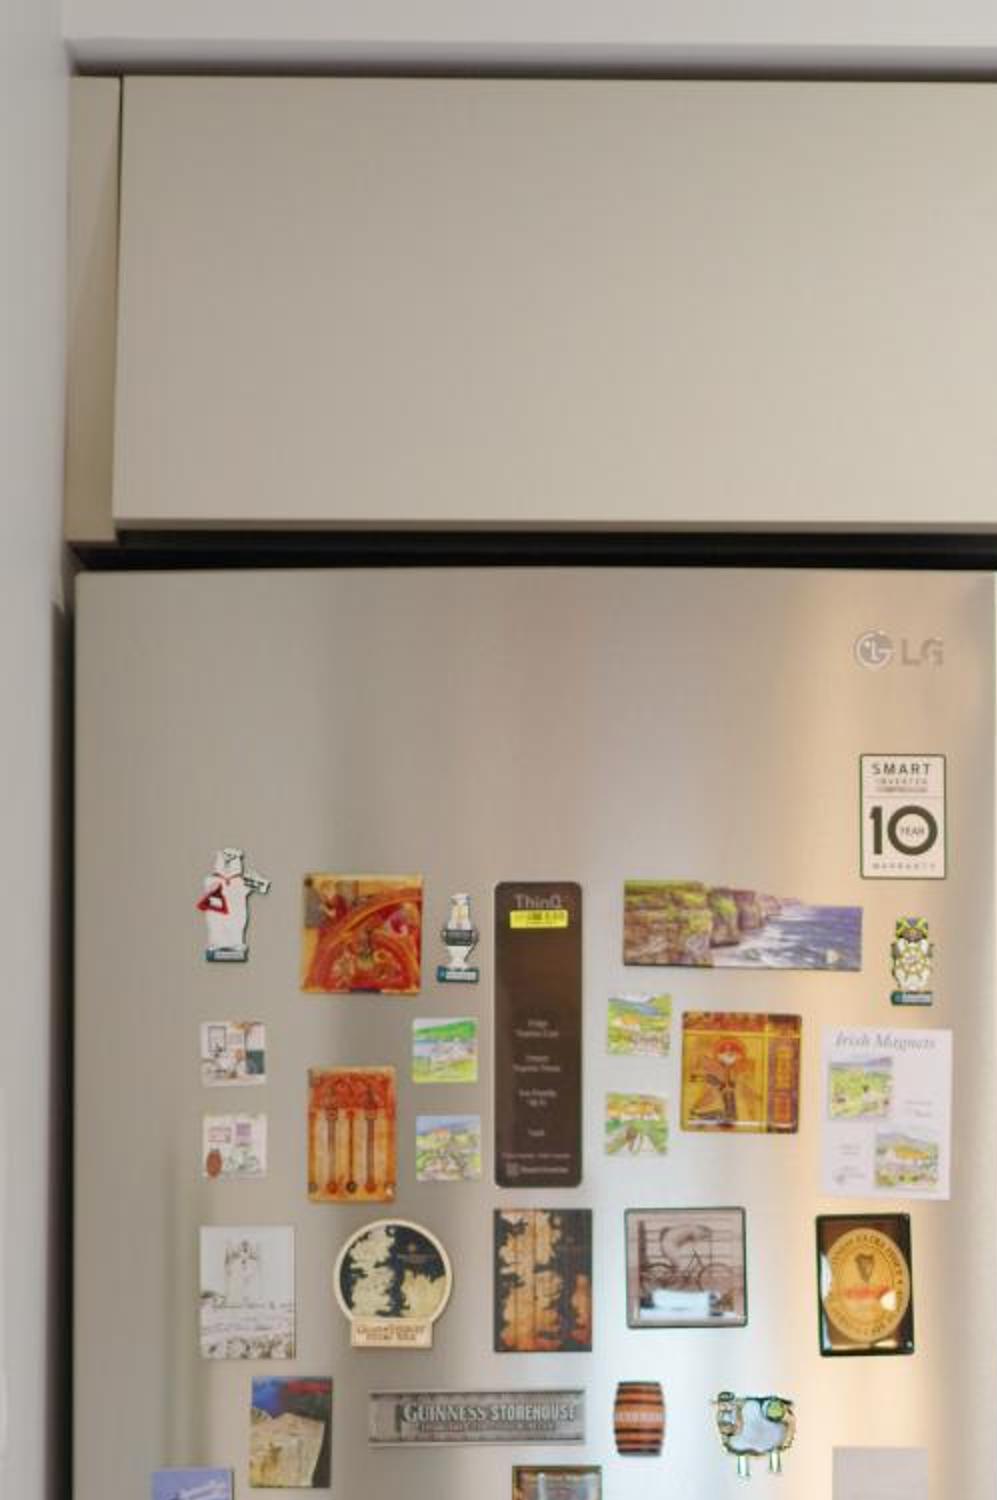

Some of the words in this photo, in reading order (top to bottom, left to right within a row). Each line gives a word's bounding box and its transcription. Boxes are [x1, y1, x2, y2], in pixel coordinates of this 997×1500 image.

[901, 638, 945, 666] LG
[871, 762, 932, 775] SMART
[870, 805, 938, 856] 10
[899, 825, 925, 836] YEAR
[403, 1402, 487, 1423] GUINNESS
[491, 1400, 577, 1423] STOREHOUSE
